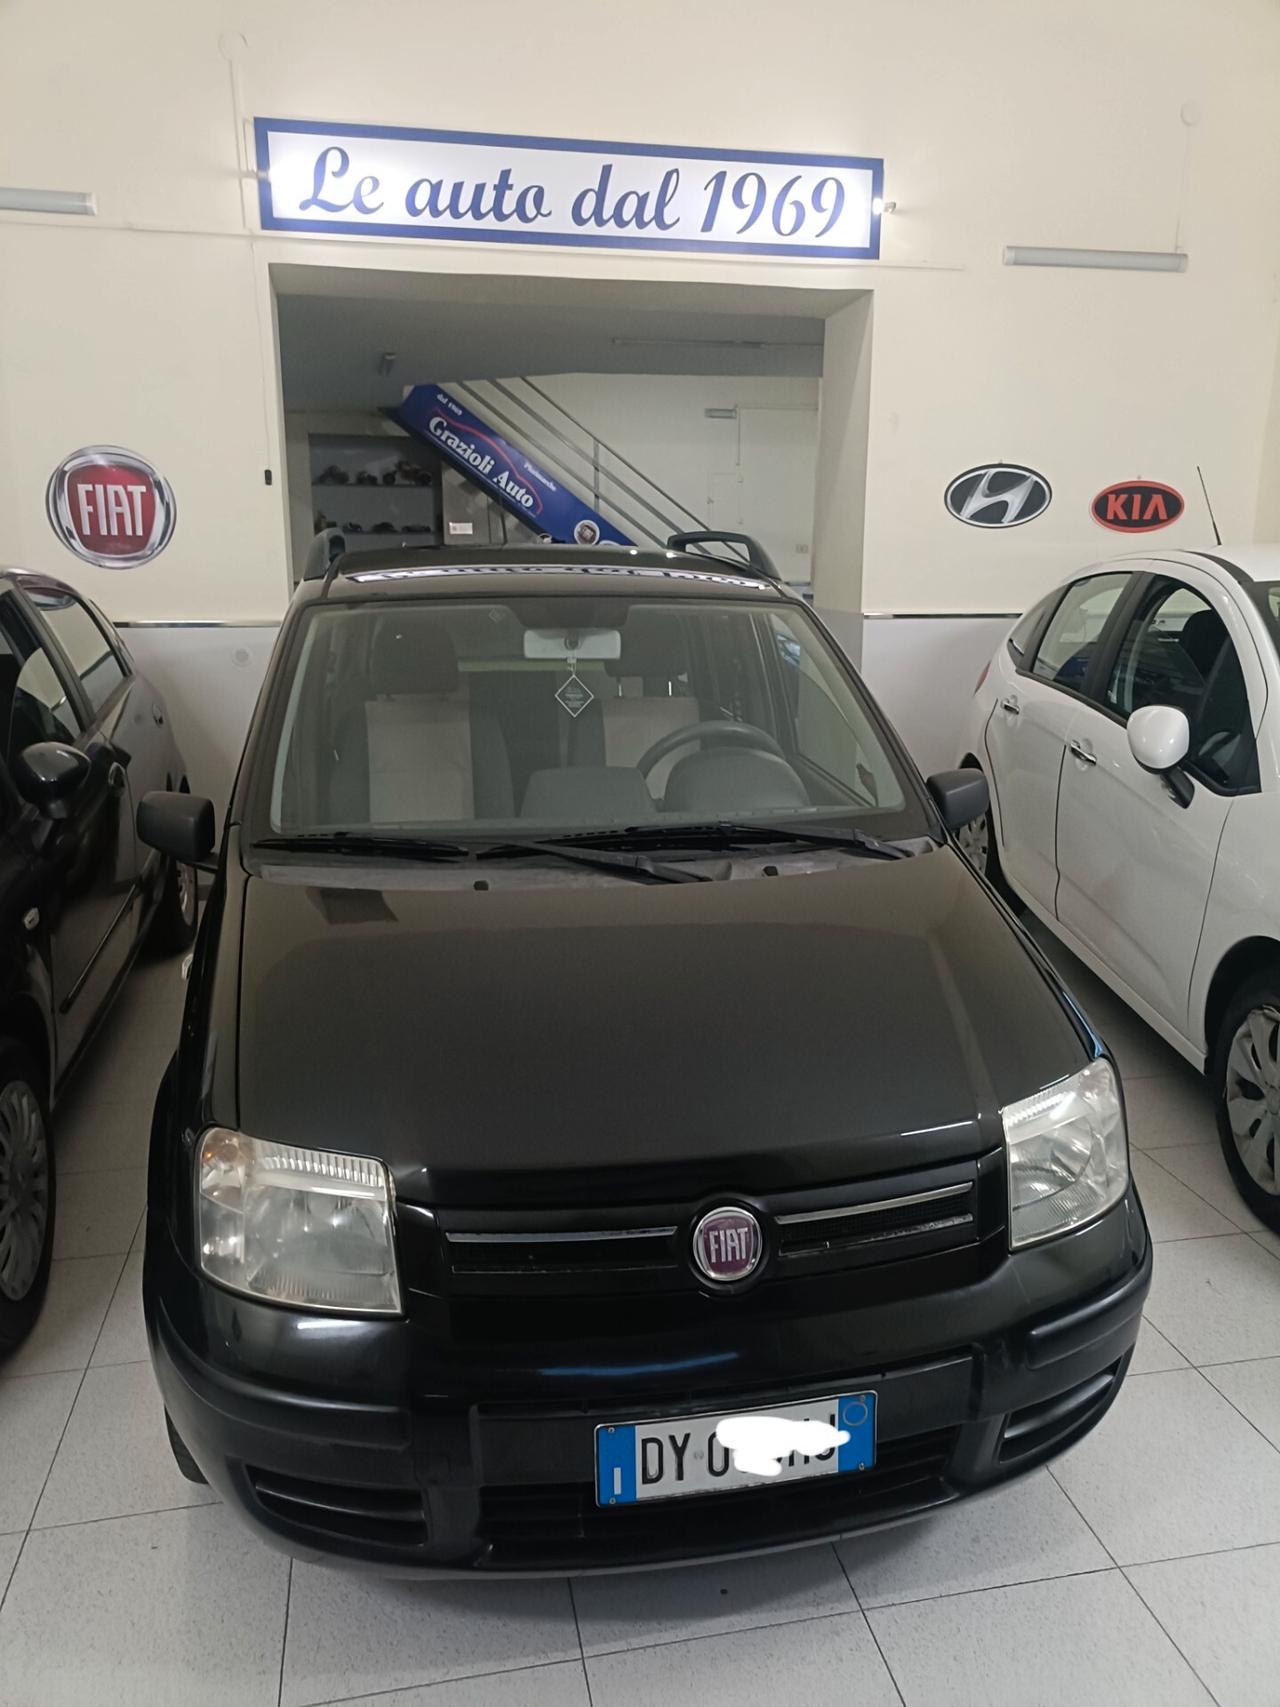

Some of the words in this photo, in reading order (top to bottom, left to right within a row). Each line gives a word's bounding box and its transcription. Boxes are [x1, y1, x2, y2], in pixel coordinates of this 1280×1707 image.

[299, 146, 384, 214] Le
[405, 168, 552, 224] auto
[571, 164, 680, 231] dal
[701, 171, 845, 238] 1969
[429, 416, 495, 475] Grazioli
[493, 471, 534, 508] Auto
[77, 484, 147, 536] FIAT
[1105, 494, 1169, 521] KIA
[709, 1227, 748, 1263] FIAT
[641, 1432, 691, 1485] DY
